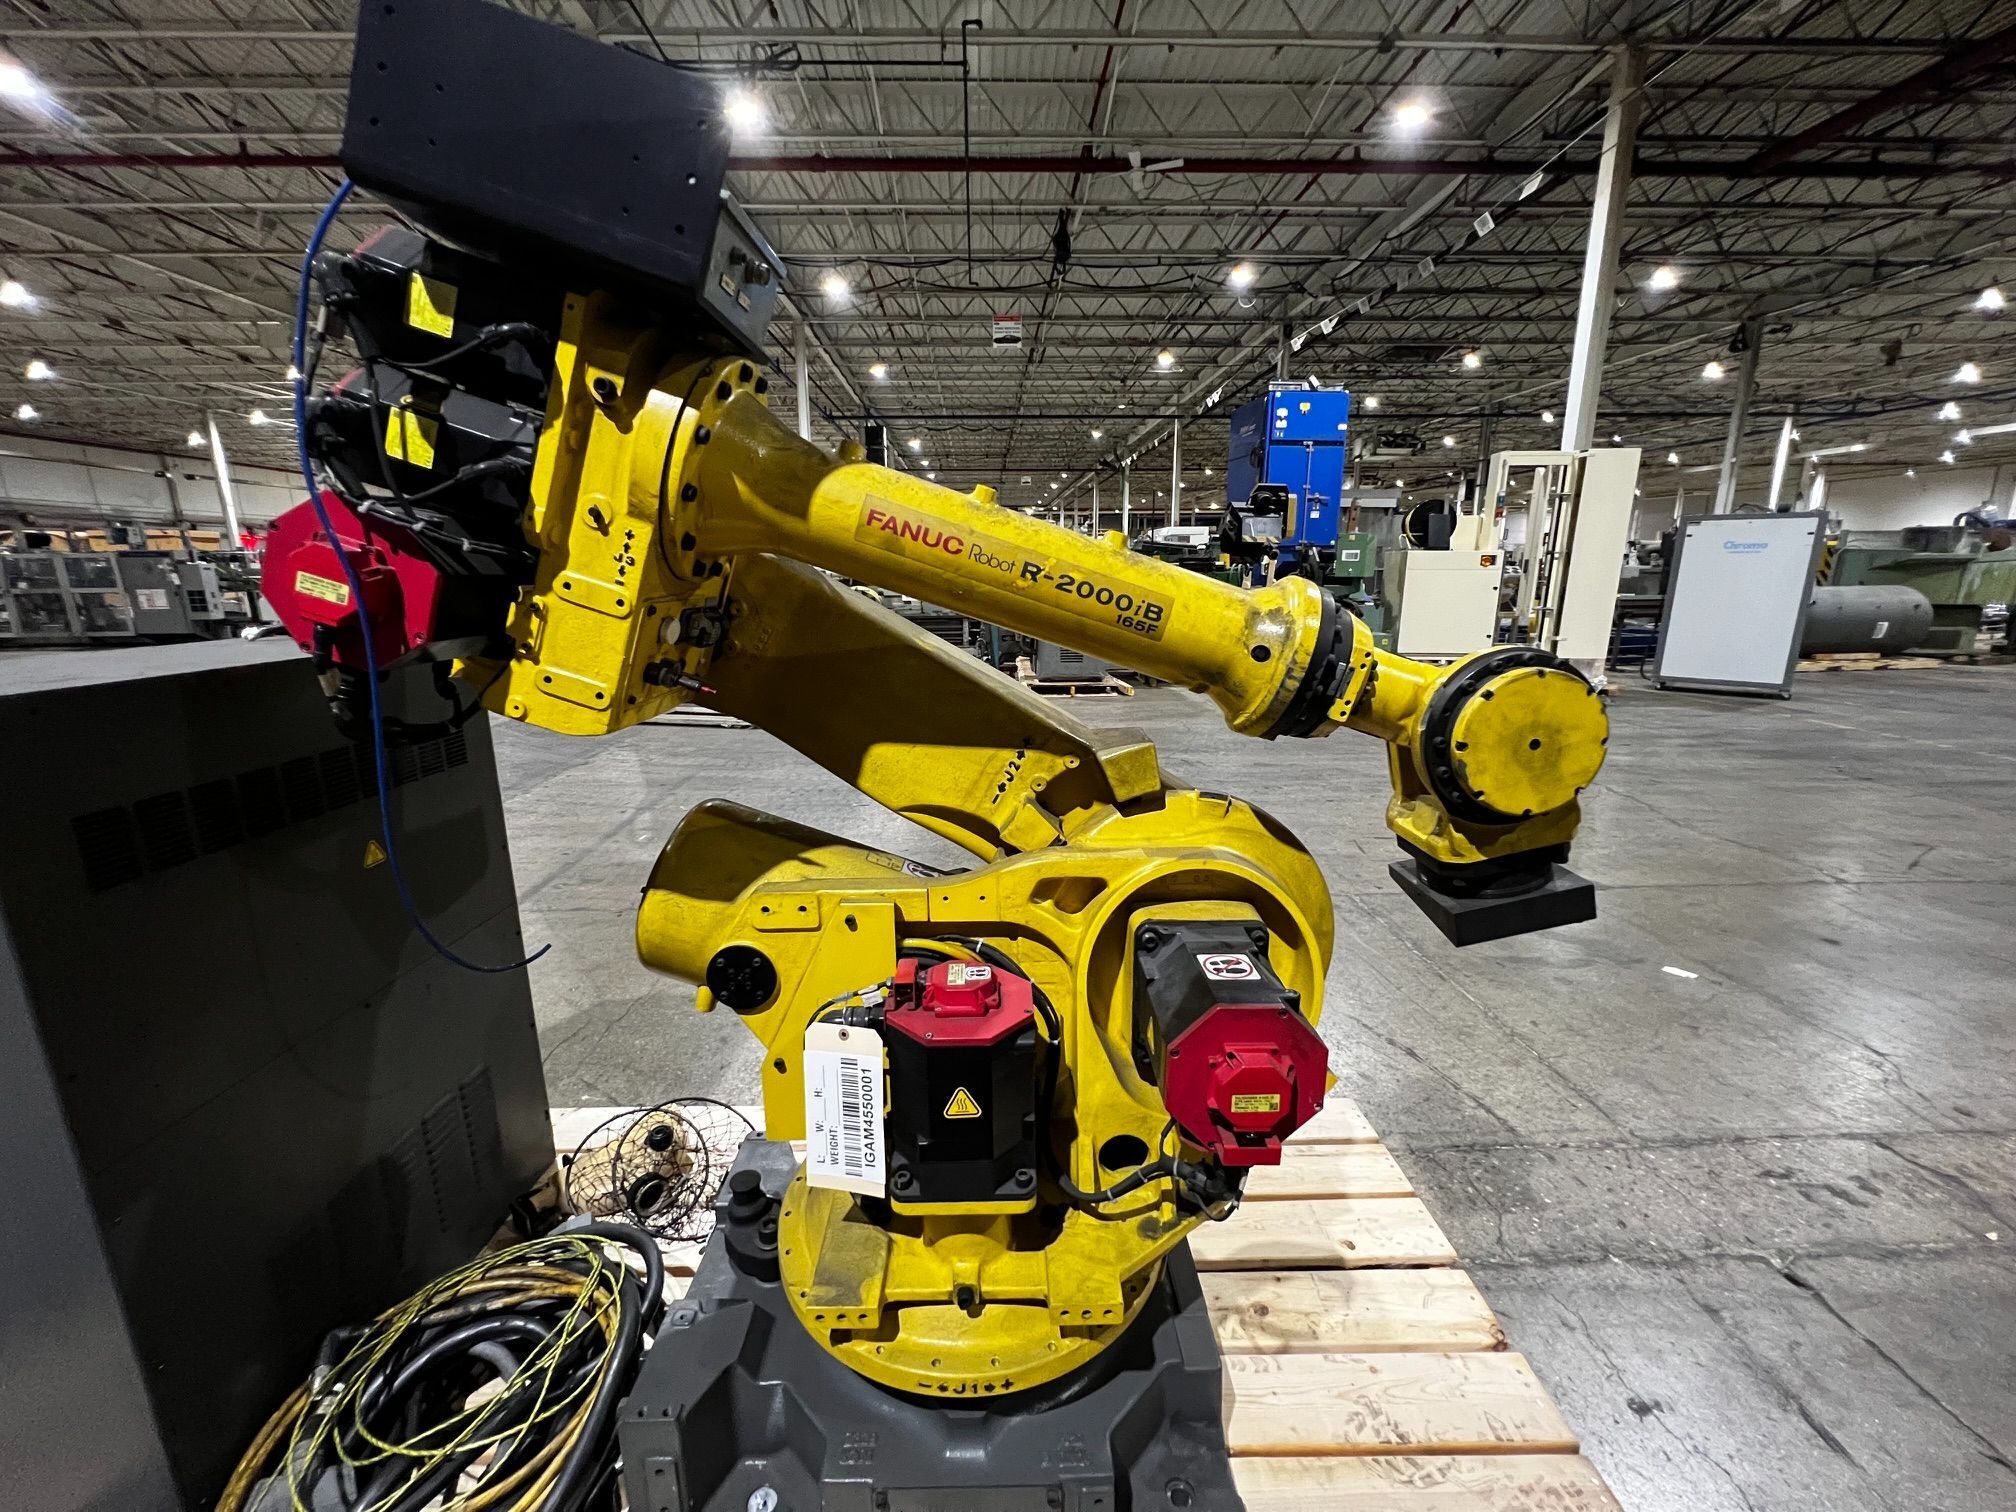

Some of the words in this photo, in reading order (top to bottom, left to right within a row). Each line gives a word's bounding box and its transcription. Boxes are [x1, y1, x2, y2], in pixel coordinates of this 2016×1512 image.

[866, 509, 965, 555] FANUC
[968, 543, 1017, 574] Robot
[1116, 613, 1159, 635] 165F
[813, 1087, 823, 1098] H:
[815, 1120, 825, 1133] W:
[860, 1067, 876, 1168] IGAM4550001
[828, 1124, 839, 1166] WEIGHT:
